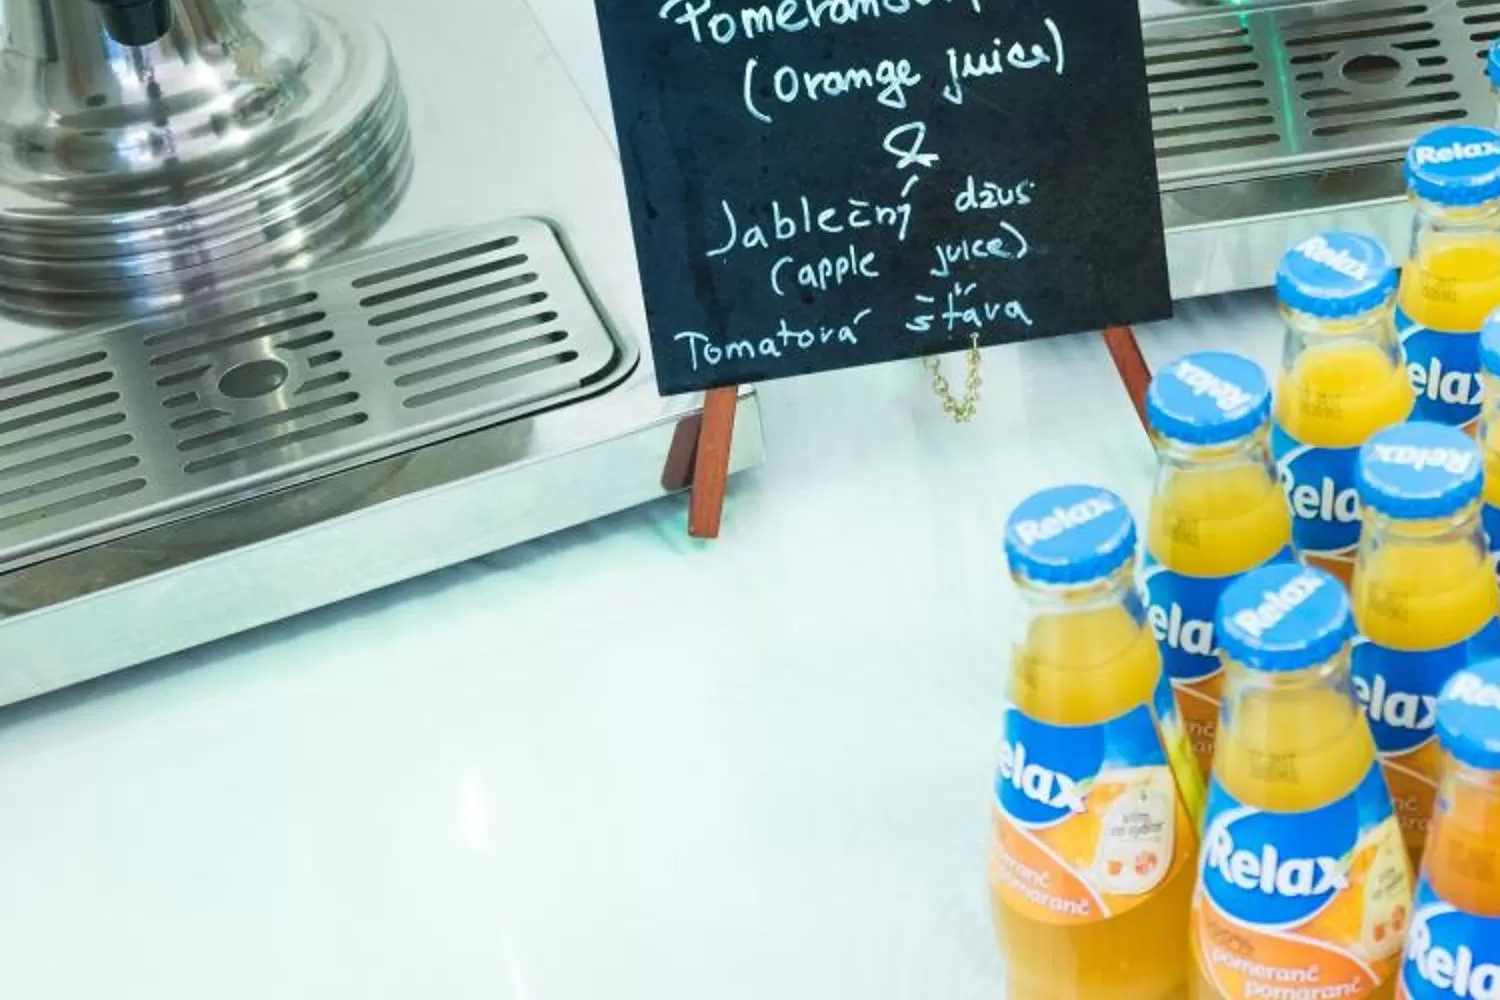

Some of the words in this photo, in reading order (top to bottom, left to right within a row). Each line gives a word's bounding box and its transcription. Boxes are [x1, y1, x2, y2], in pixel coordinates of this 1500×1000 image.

[771, 244, 881, 297] (apple
[929, 221, 1028, 277] juice)
[1296, 236, 1369, 280] Relax
[1407, 357, 1484, 405] elax
[1014, 497, 1115, 546] Relax
[1277, 463, 1361, 522] Rela
[1149, 602, 1221, 656] ela
[1237, 573, 1328, 637] Relax
[1351, 673, 1437, 730] elax
[998, 741, 1088, 812] elax
[1207, 824, 1349, 896] Relax
